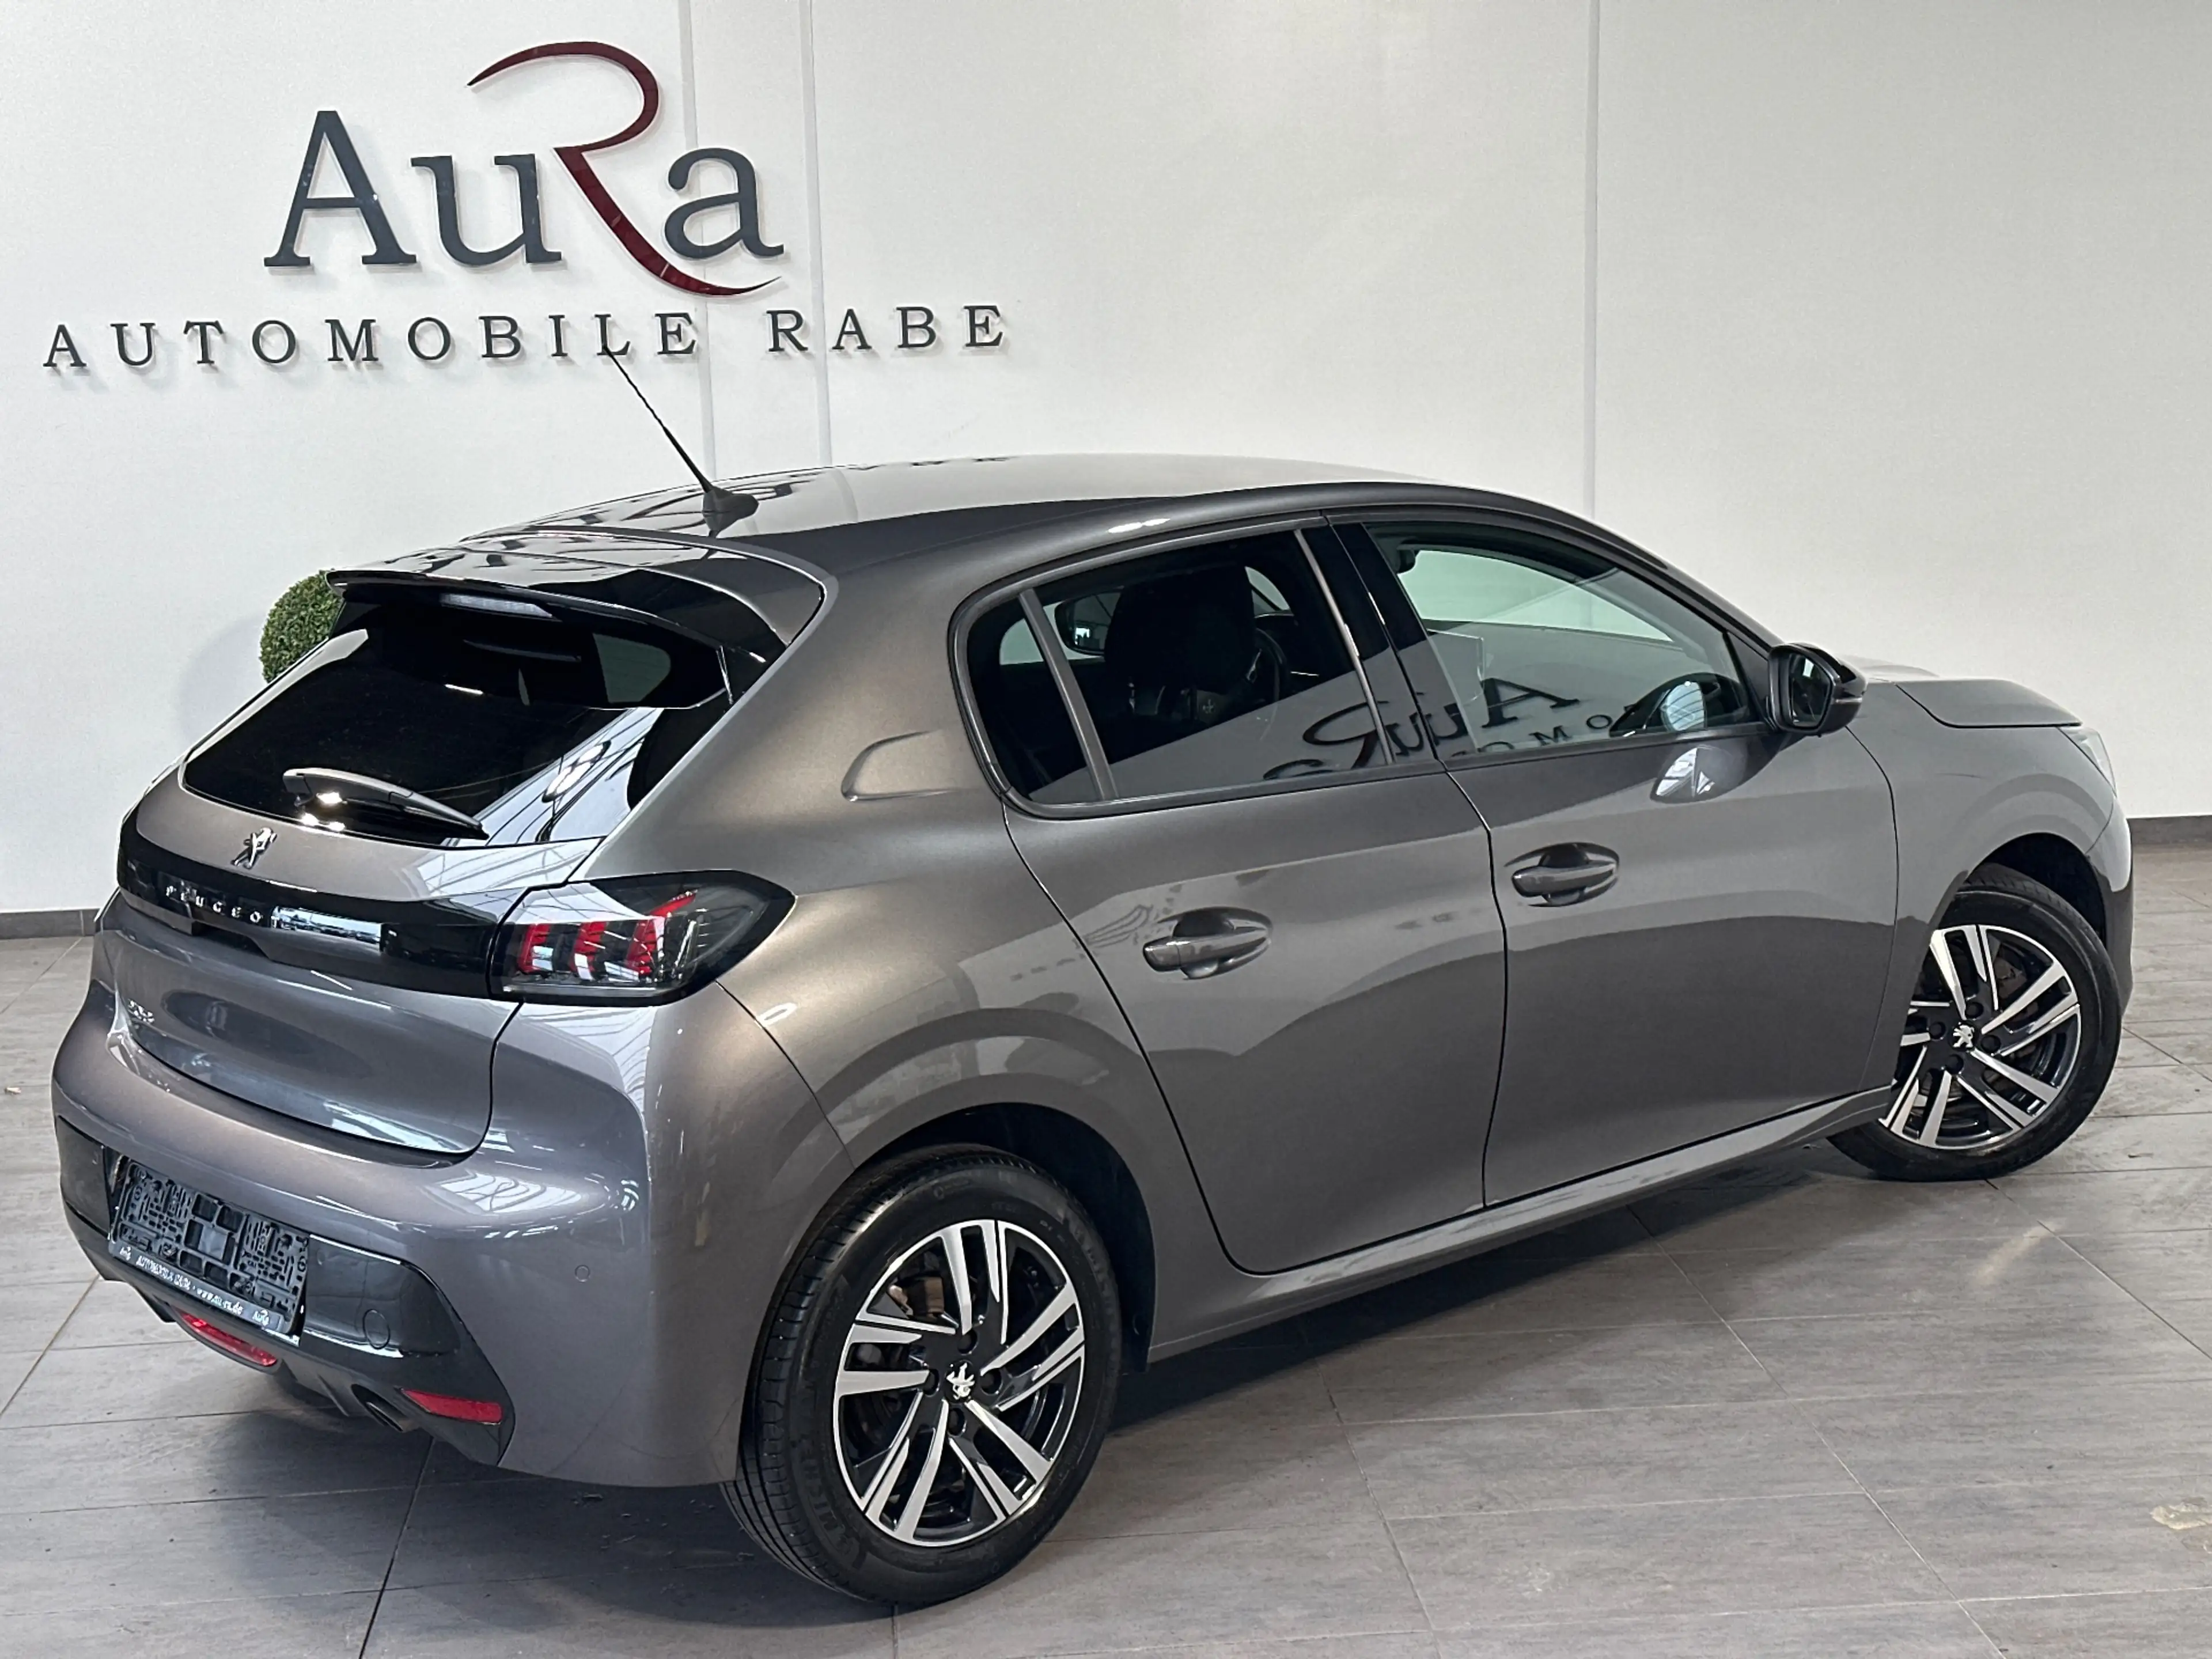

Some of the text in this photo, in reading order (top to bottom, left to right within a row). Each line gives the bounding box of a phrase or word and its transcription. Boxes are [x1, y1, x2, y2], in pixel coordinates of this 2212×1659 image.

[264, 41, 783, 297] AuRa
[43, 306, 1002, 368] AUTOMOBILE RABE
